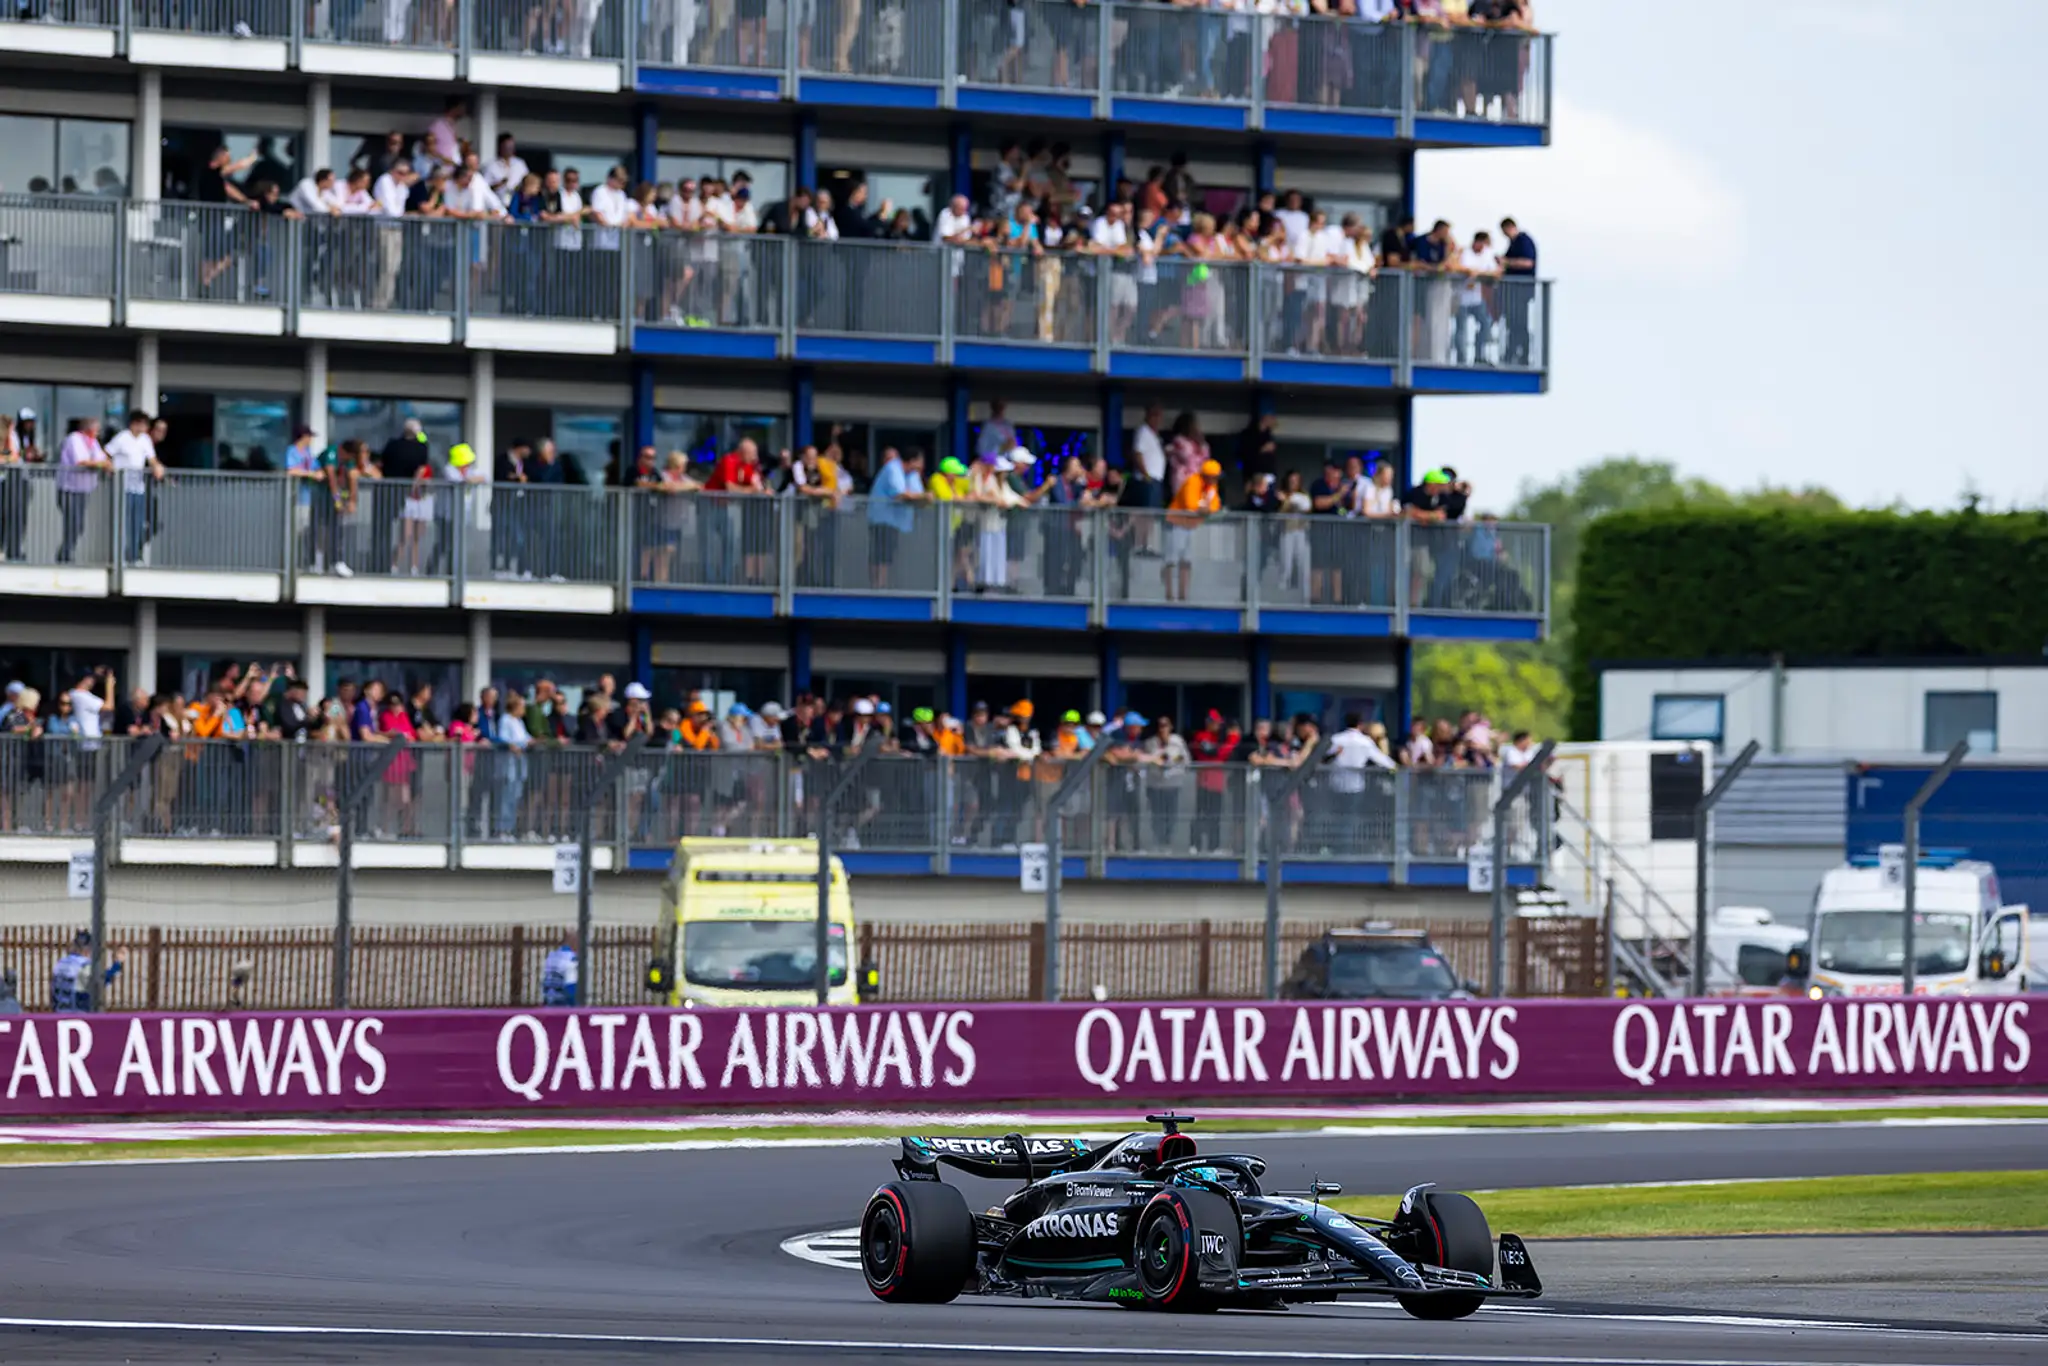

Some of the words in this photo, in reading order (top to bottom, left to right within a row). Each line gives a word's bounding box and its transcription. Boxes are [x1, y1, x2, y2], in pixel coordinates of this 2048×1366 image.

[79, 871, 90, 890] 2
[563, 867, 575, 886] 3
[1031, 867, 1042, 881] 4
[1075, 1007, 1269, 1092] QATAR
[1281, 1006, 1519, 1081] AIRWAYS
[1613, 1003, 1796, 1086] QATAR
[1808, 1001, 2030, 1074] AIRWAYS
[0, 1019, 97, 1098] AR
[114, 1017, 386, 1096] AIRWAYS
[496, 1013, 708, 1100] QATAR
[719, 1010, 976, 1089] AIRWAYS
[1073, 1184, 1115, 1197] TeamViewer
[1027, 1212, 1119, 1239] PETRONAS
[1201, 1235, 1225, 1254] IWC
[1500, 1250, 1525, 1265] INEOS
